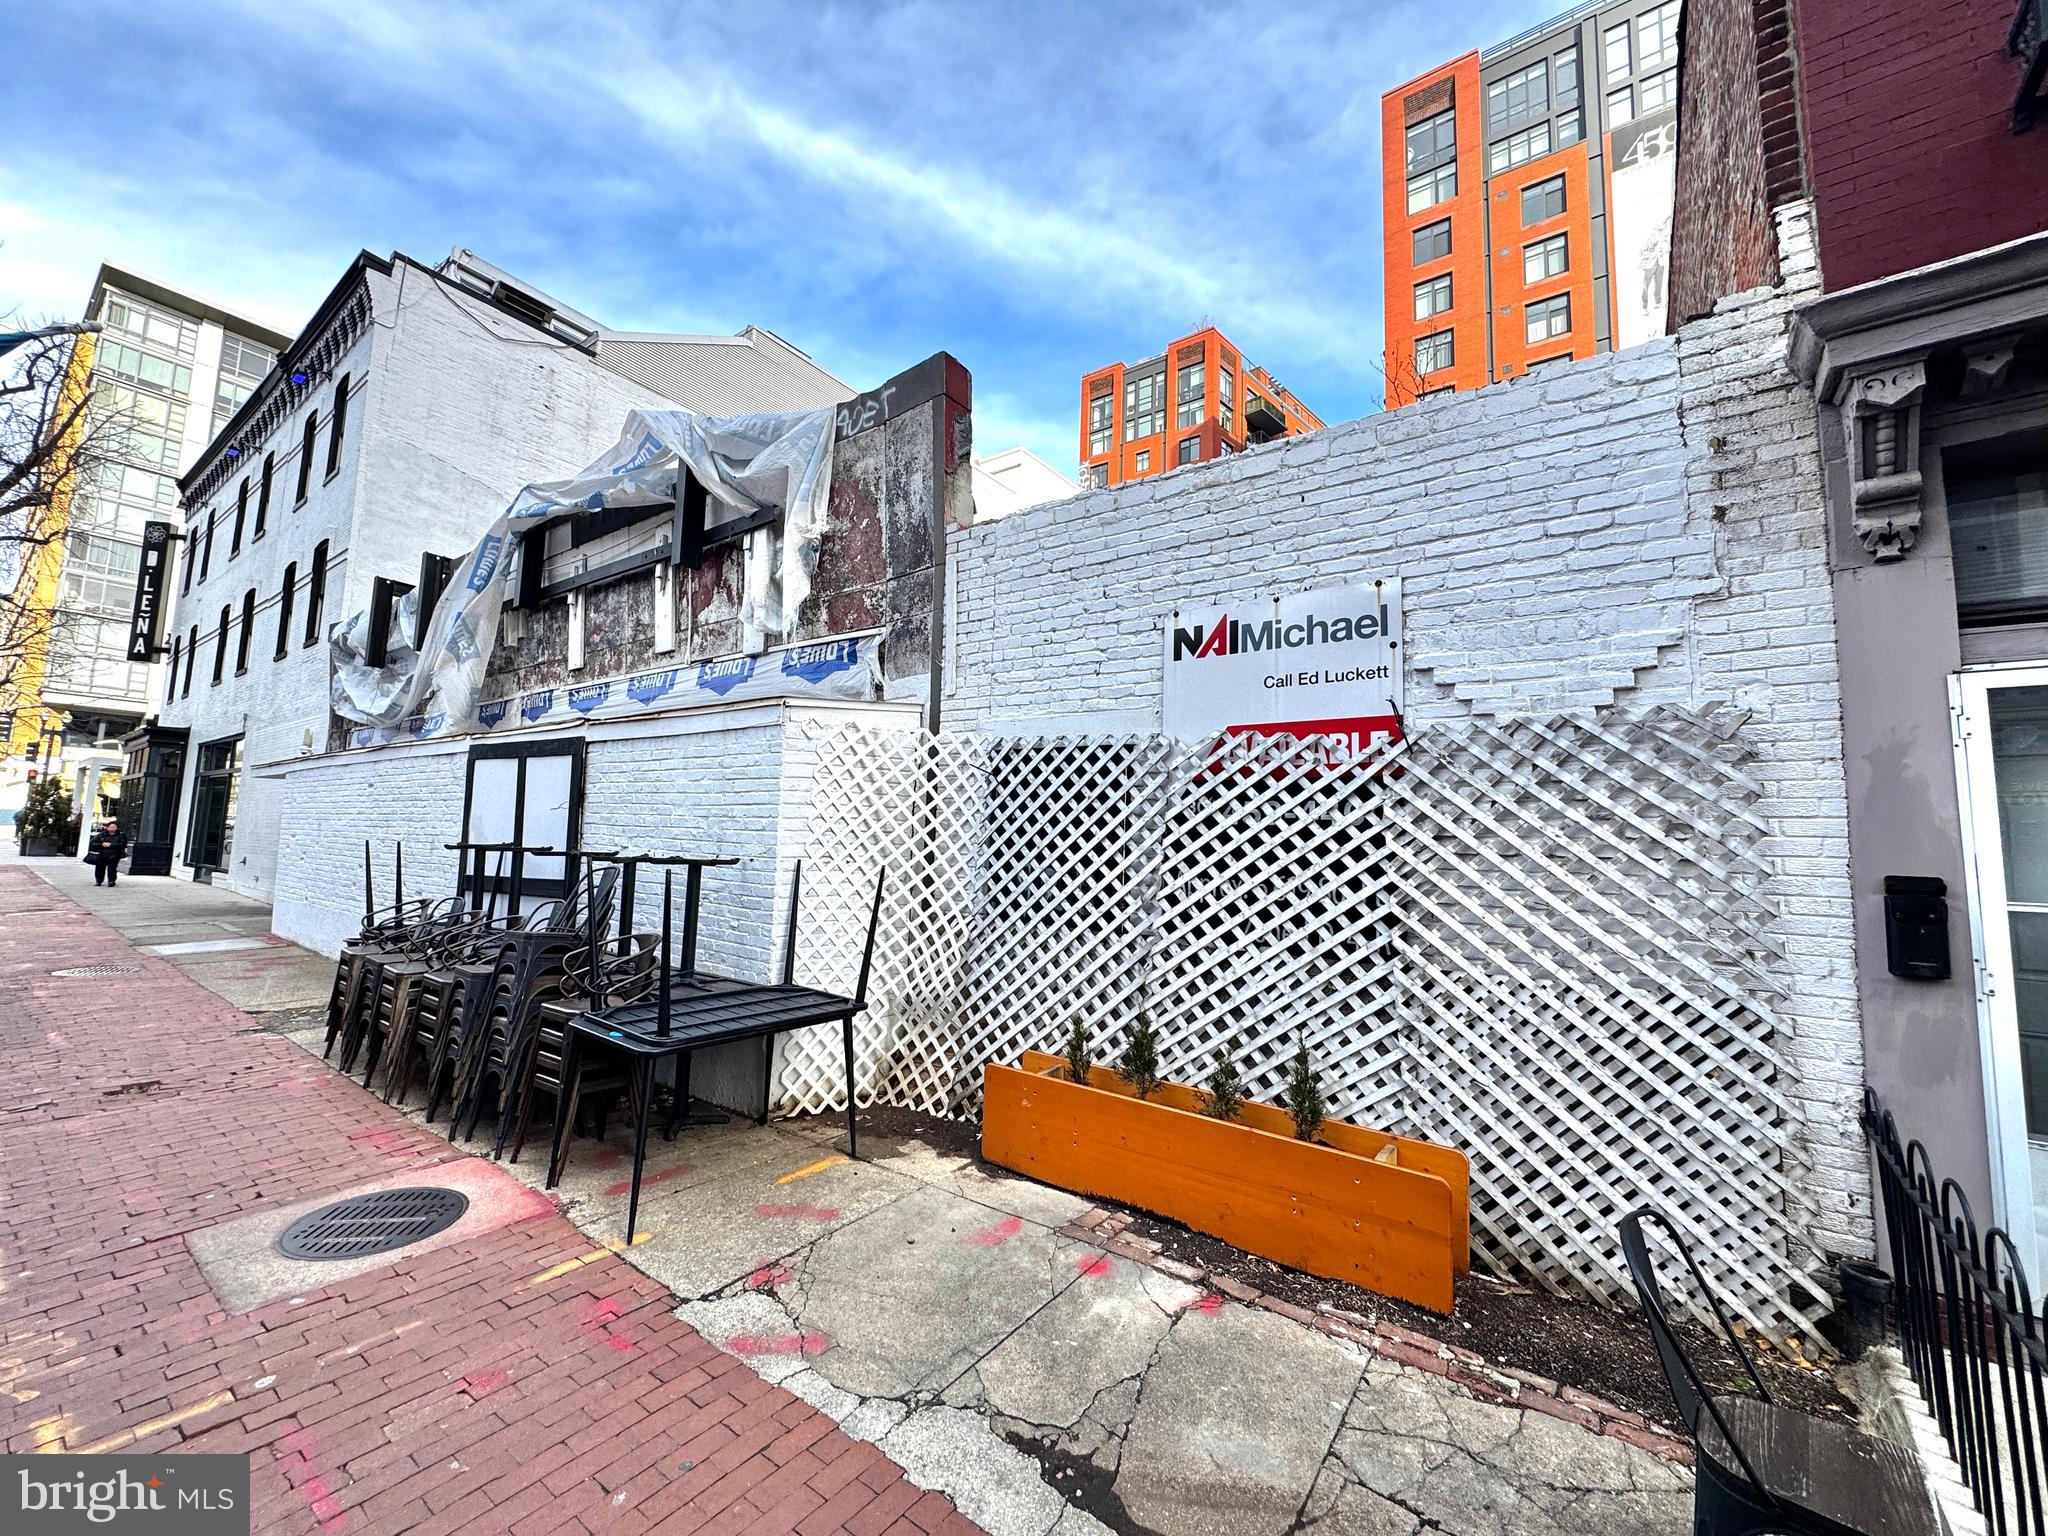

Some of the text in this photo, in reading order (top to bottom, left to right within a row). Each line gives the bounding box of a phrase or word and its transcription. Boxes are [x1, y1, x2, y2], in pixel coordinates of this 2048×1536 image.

[789, 641, 849, 668] LOWE'S
[704, 657, 750, 680] LOWE'S
[1263, 665, 1390, 689] Call Ed Luckett
[633, 671, 671, 692] LOWE'S
